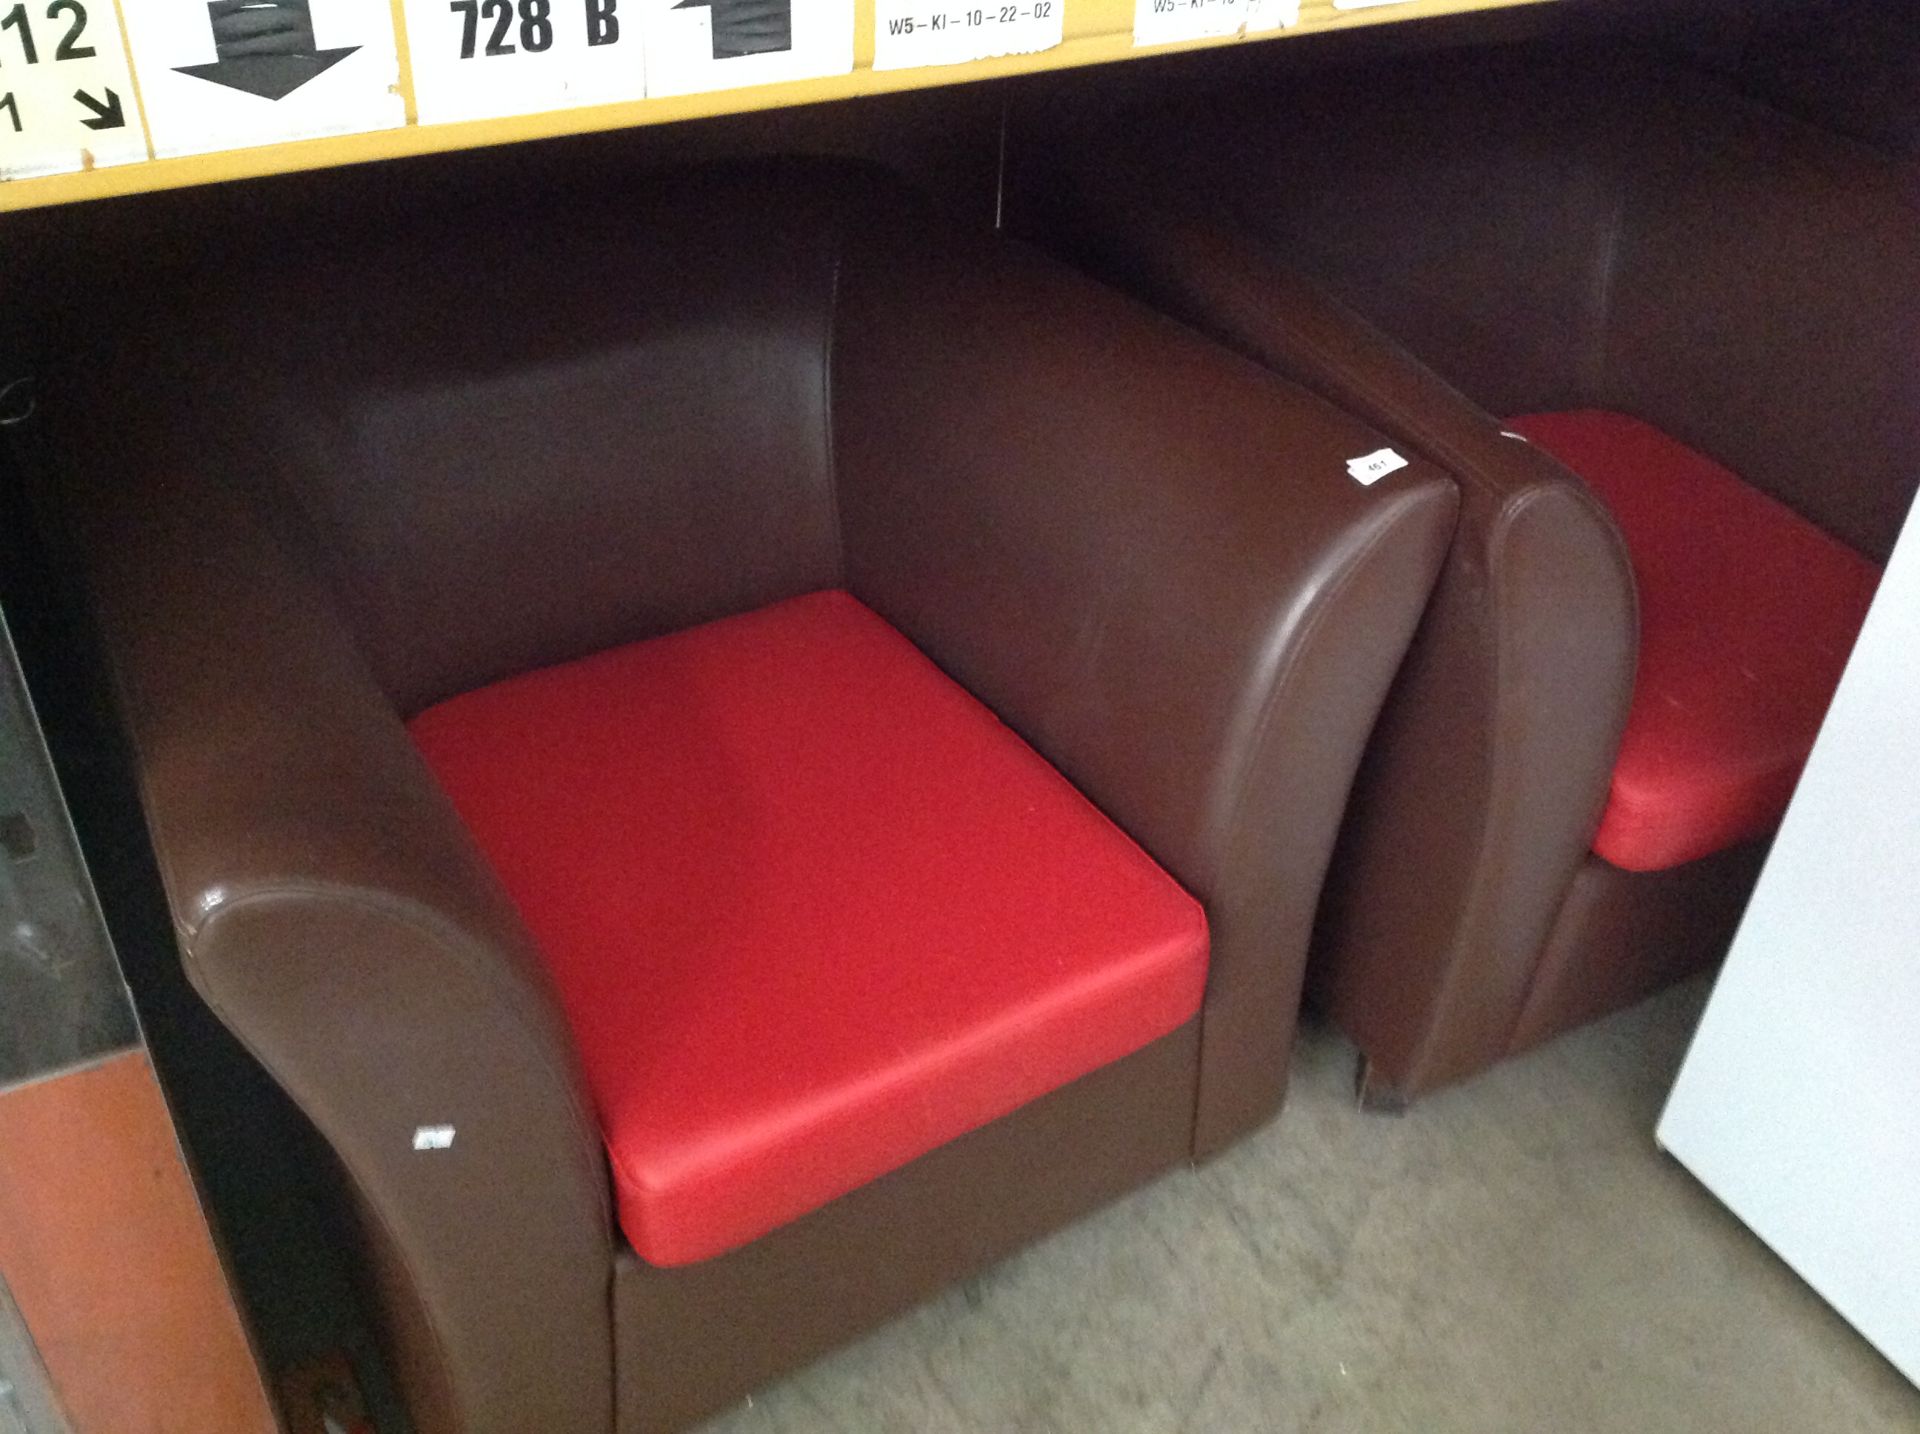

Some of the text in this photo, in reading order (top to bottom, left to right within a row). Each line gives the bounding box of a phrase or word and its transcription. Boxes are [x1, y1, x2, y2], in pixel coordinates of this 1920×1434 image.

[0, 0, 96, 67] 12
[450, 0, 619, 59] 728 B
[888, 2, 1052, 35] W5-KI-10-22-02
